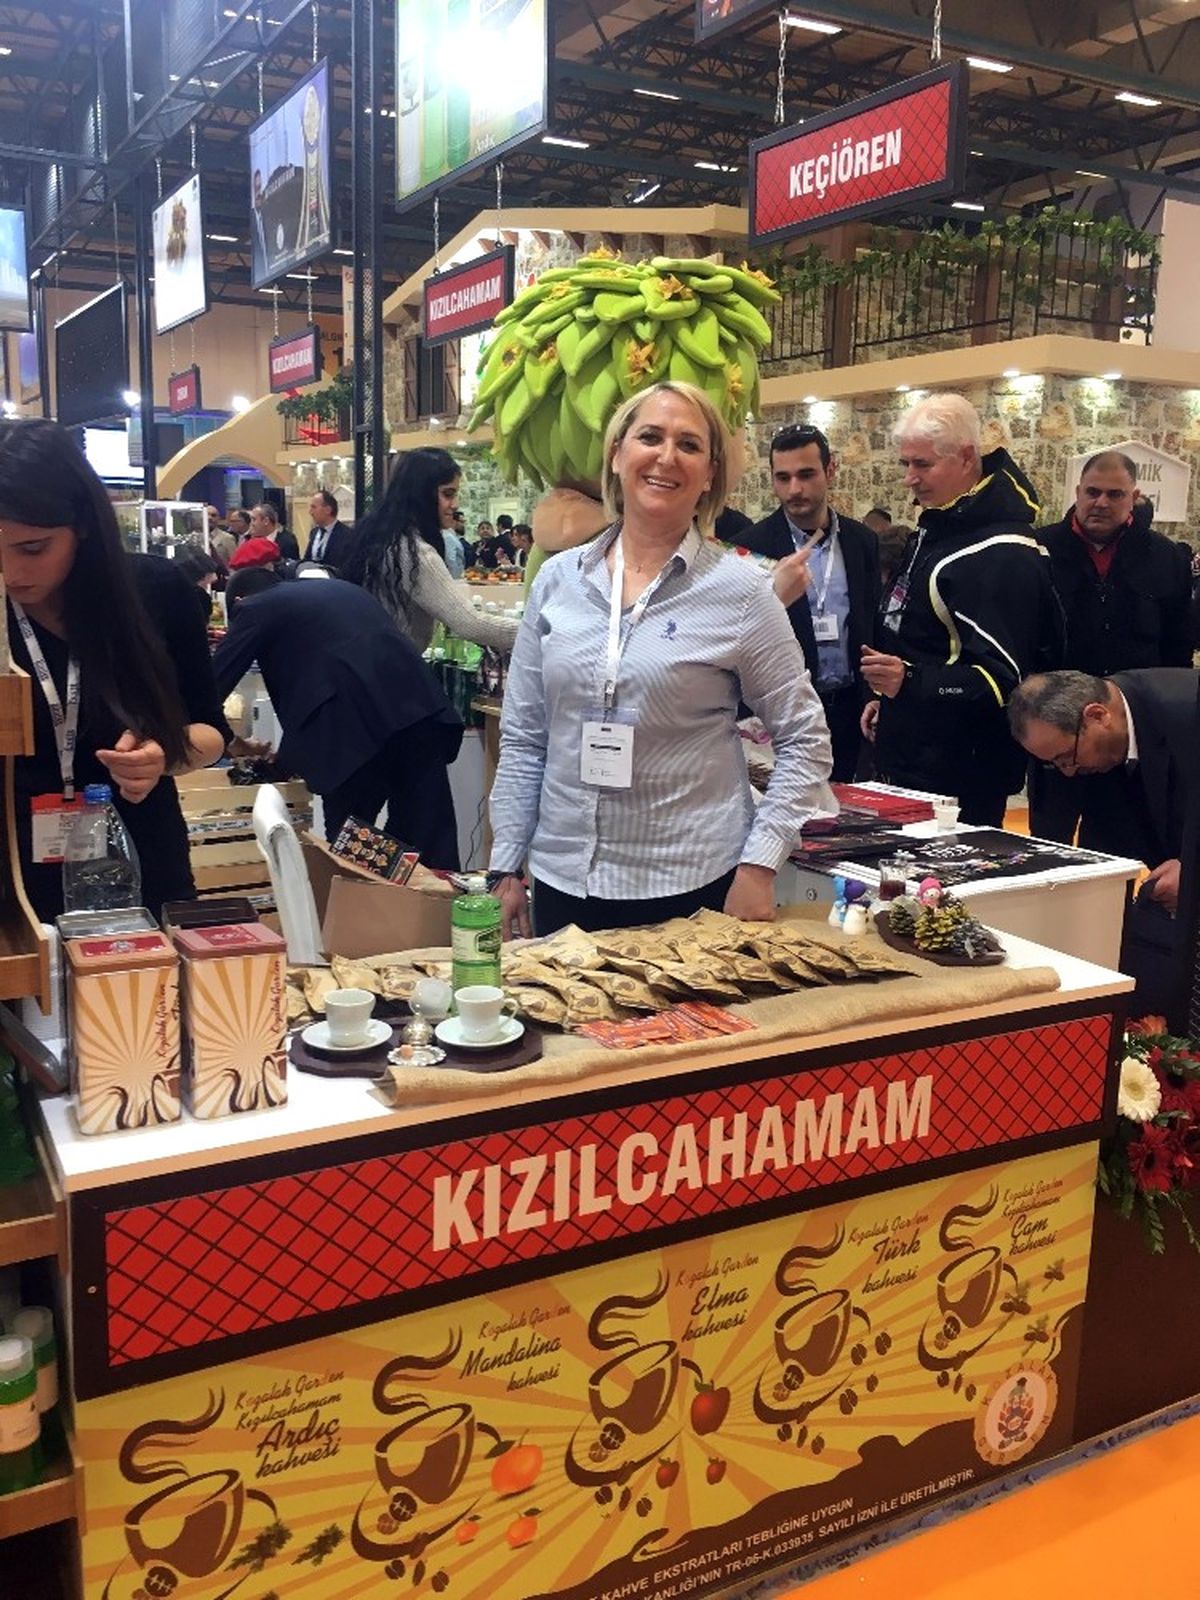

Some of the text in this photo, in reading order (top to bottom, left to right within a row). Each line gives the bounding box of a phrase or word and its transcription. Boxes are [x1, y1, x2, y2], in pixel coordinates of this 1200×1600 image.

[789, 127, 902, 199] KEÇİÖREN
[430, 274, 502, 321] KIZILCAHAMAM
[432, 1075, 934, 1252] KIZILCAHAMAM
[872, 1227, 921, 1265] Türk
[691, 1282, 750, 1316] Elma
[459, 1332, 562, 1380] Mandalina
[600, 1577, 650, 1600] KAHVE
[653, 1539, 743, 1585] EKSTRATLARI
[811, 1497, 854, 1522] UYGUN
